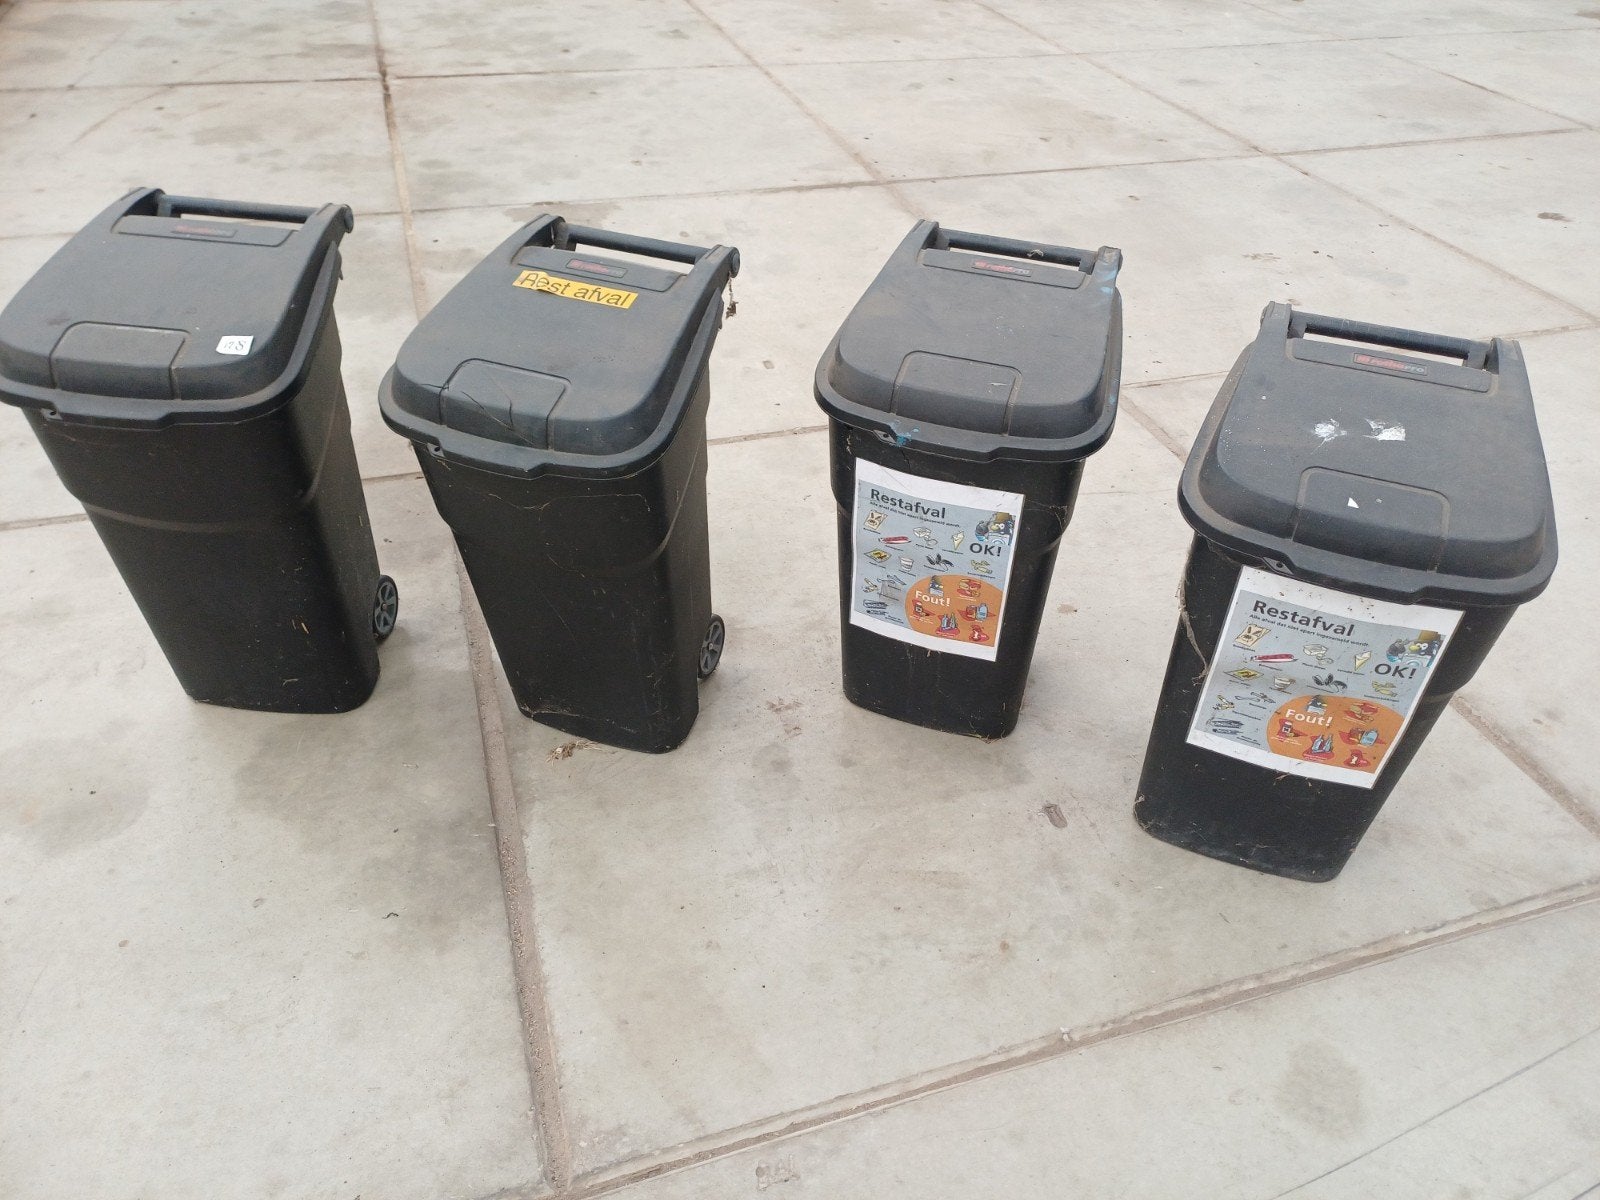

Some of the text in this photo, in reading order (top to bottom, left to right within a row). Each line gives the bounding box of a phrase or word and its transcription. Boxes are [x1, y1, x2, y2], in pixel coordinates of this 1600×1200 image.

[520, 272, 631, 306] Rest afval
[870, 488, 946, 519] Restafval
[969, 542, 1002, 557] OK!
[915, 590, 951, 607] Fout!
[1253, 600, 1355, 637] Restafval
[1374, 663, 1417, 679] OK!
[1285, 709, 1333, 727] Fout!
